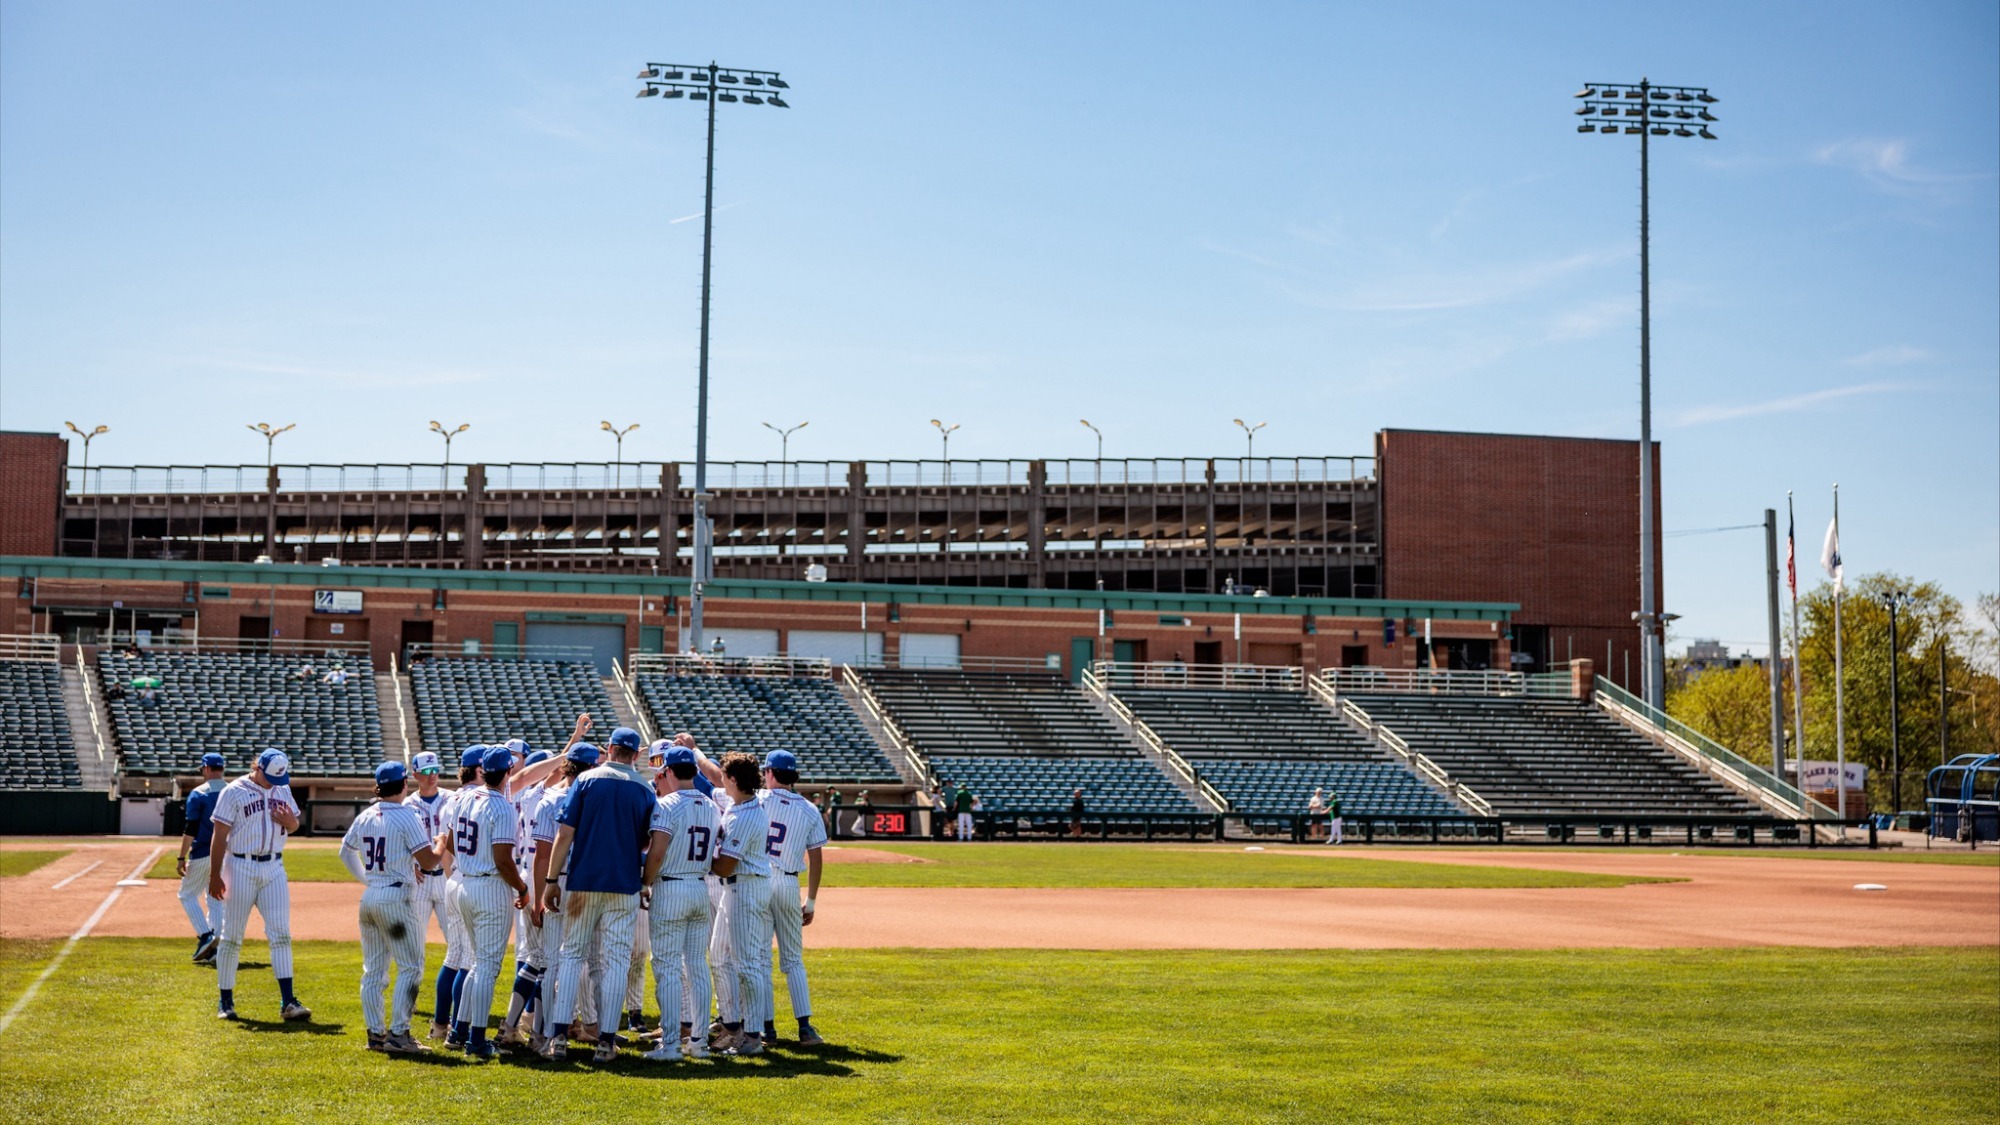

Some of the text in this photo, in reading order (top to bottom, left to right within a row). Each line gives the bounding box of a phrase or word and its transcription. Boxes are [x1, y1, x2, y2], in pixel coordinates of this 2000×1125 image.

[1803, 767, 1856, 781] LAKE BONE
[243, 799, 265, 818] RIVER
[362, 836, 386, 872] 34
[457, 816, 479, 856] 23
[687, 825, 711, 862] 13
